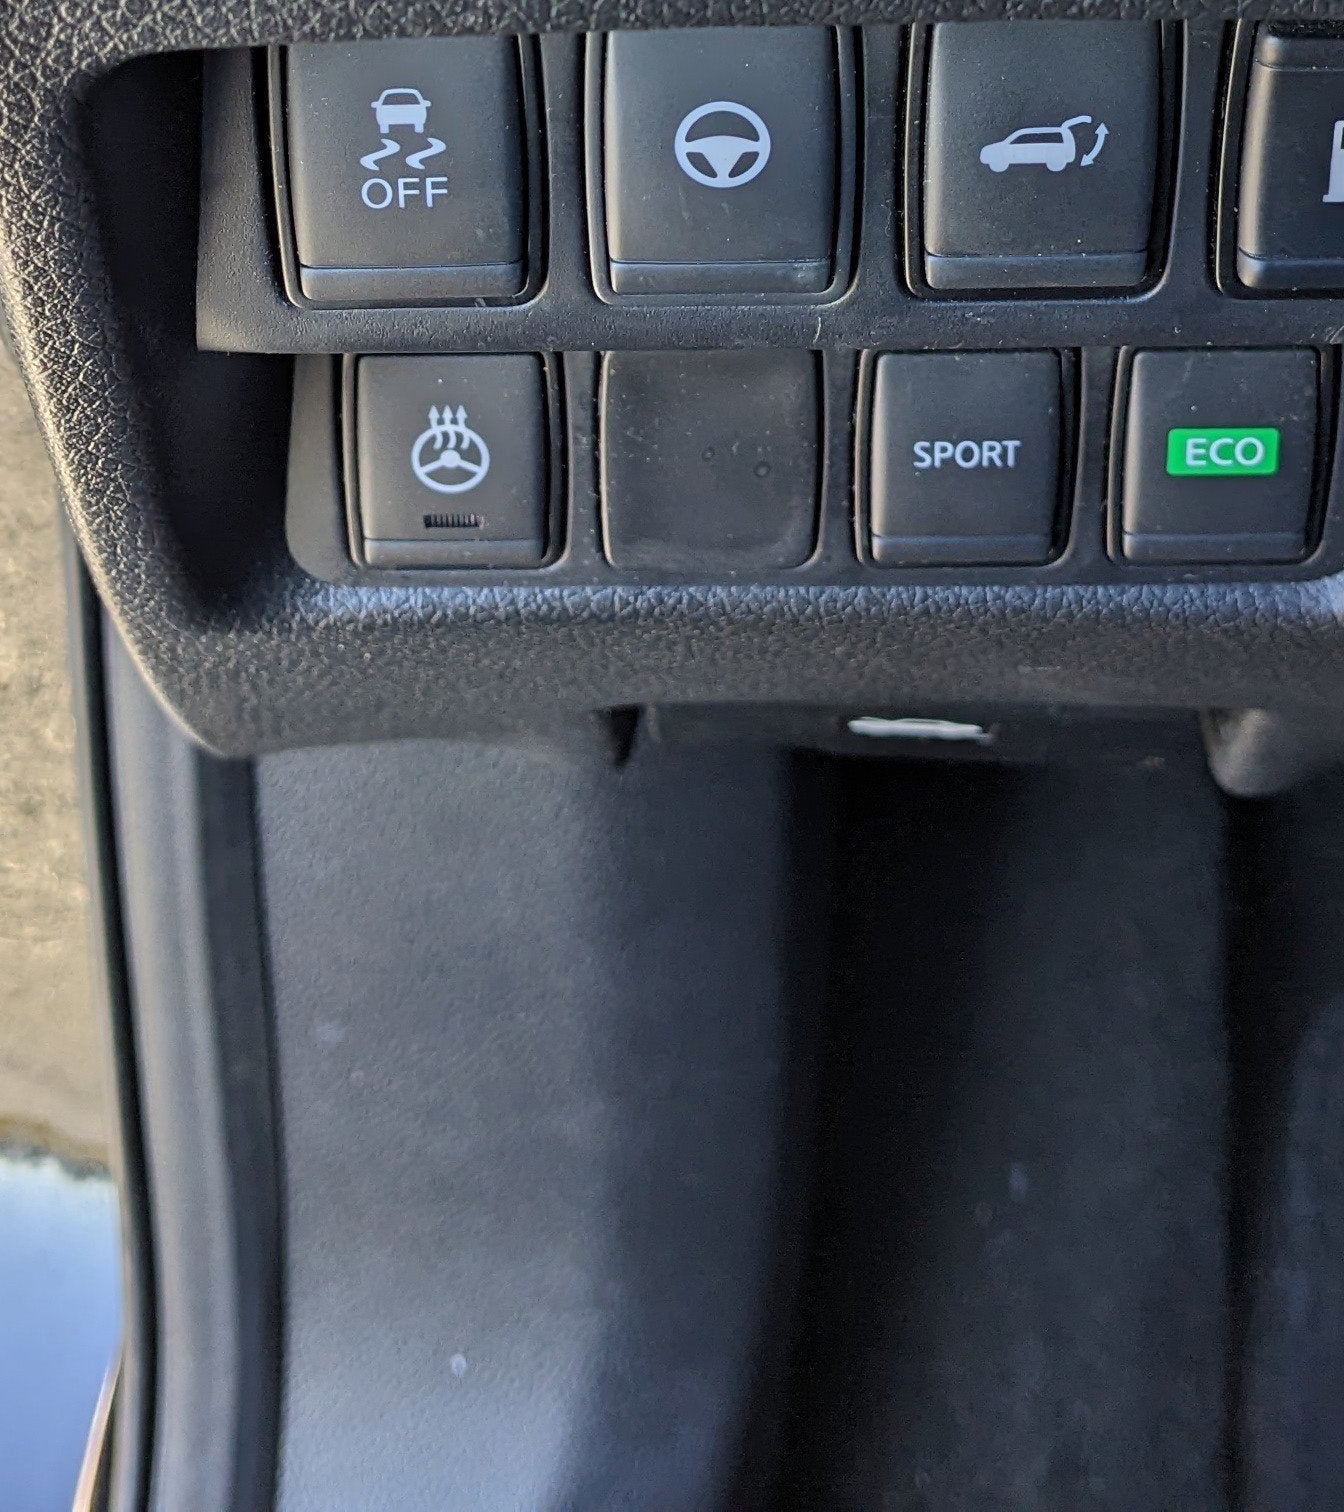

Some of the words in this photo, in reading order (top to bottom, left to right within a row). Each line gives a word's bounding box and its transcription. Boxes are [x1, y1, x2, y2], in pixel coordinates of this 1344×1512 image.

[360, 175, 449, 210] OFF
[912, 440, 1021, 469] SPORT
[1184, 436, 1265, 468] ECO
